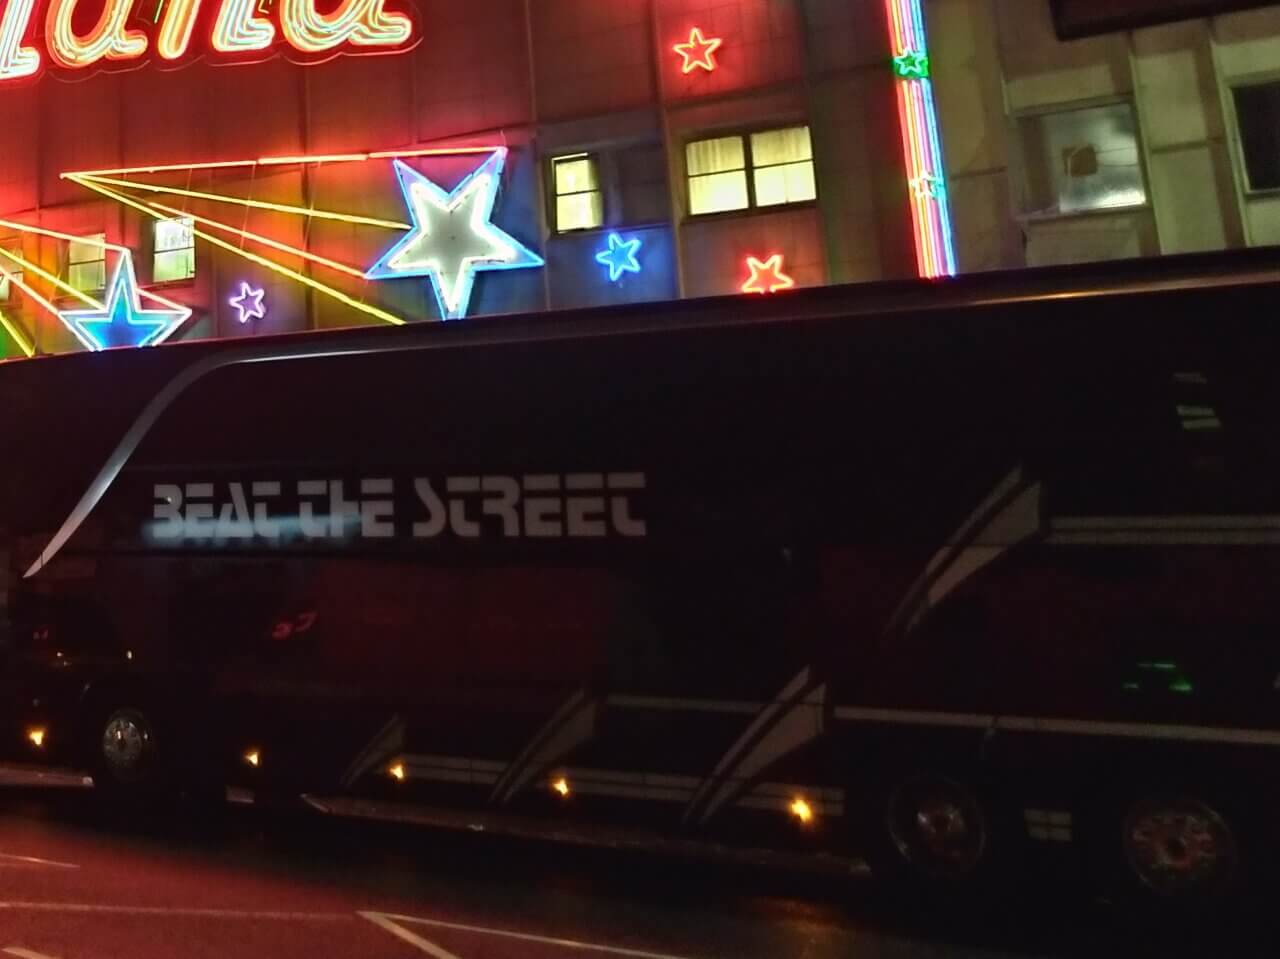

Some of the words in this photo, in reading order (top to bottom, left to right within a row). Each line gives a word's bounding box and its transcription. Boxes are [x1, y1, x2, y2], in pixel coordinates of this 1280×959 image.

[152, 480, 282, 539] BEAT
[297, 477, 395, 538] THE
[412, 471, 646, 538] STREET
